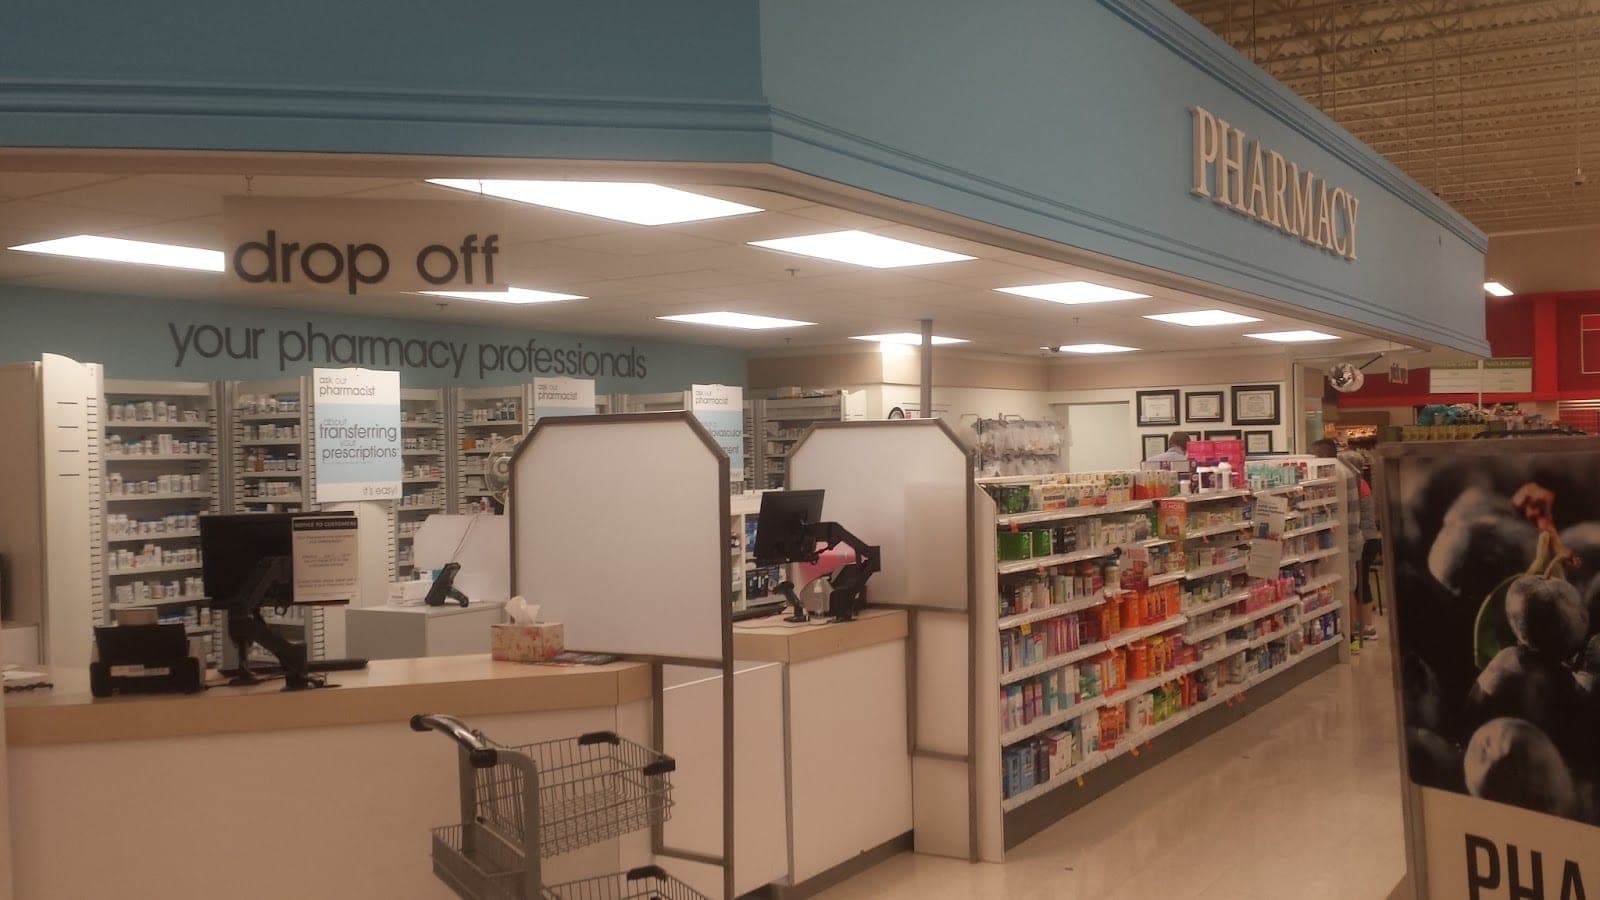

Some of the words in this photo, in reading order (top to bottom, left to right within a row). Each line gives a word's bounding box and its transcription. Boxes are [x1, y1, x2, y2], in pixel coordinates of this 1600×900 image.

[1188, 105, 1360, 261] PHARMACY
[233, 230, 389, 295] drop
[416, 233, 499, 285] off
[168, 322, 265, 367] your
[279, 322, 467, 378] pharmacy
[479, 338, 647, 380] professionals
[319, 376, 333, 385] ask
[335, 376, 348, 385] our
[319, 385, 376, 398] pharmacist
[537, 391, 578, 402] pharmacist
[695, 396, 728, 405] pharmacist
[323, 418, 348, 427] about
[319, 423, 397, 442] transferring
[322, 446, 397, 461] prescriptions
[375, 485, 397, 497] easy!
